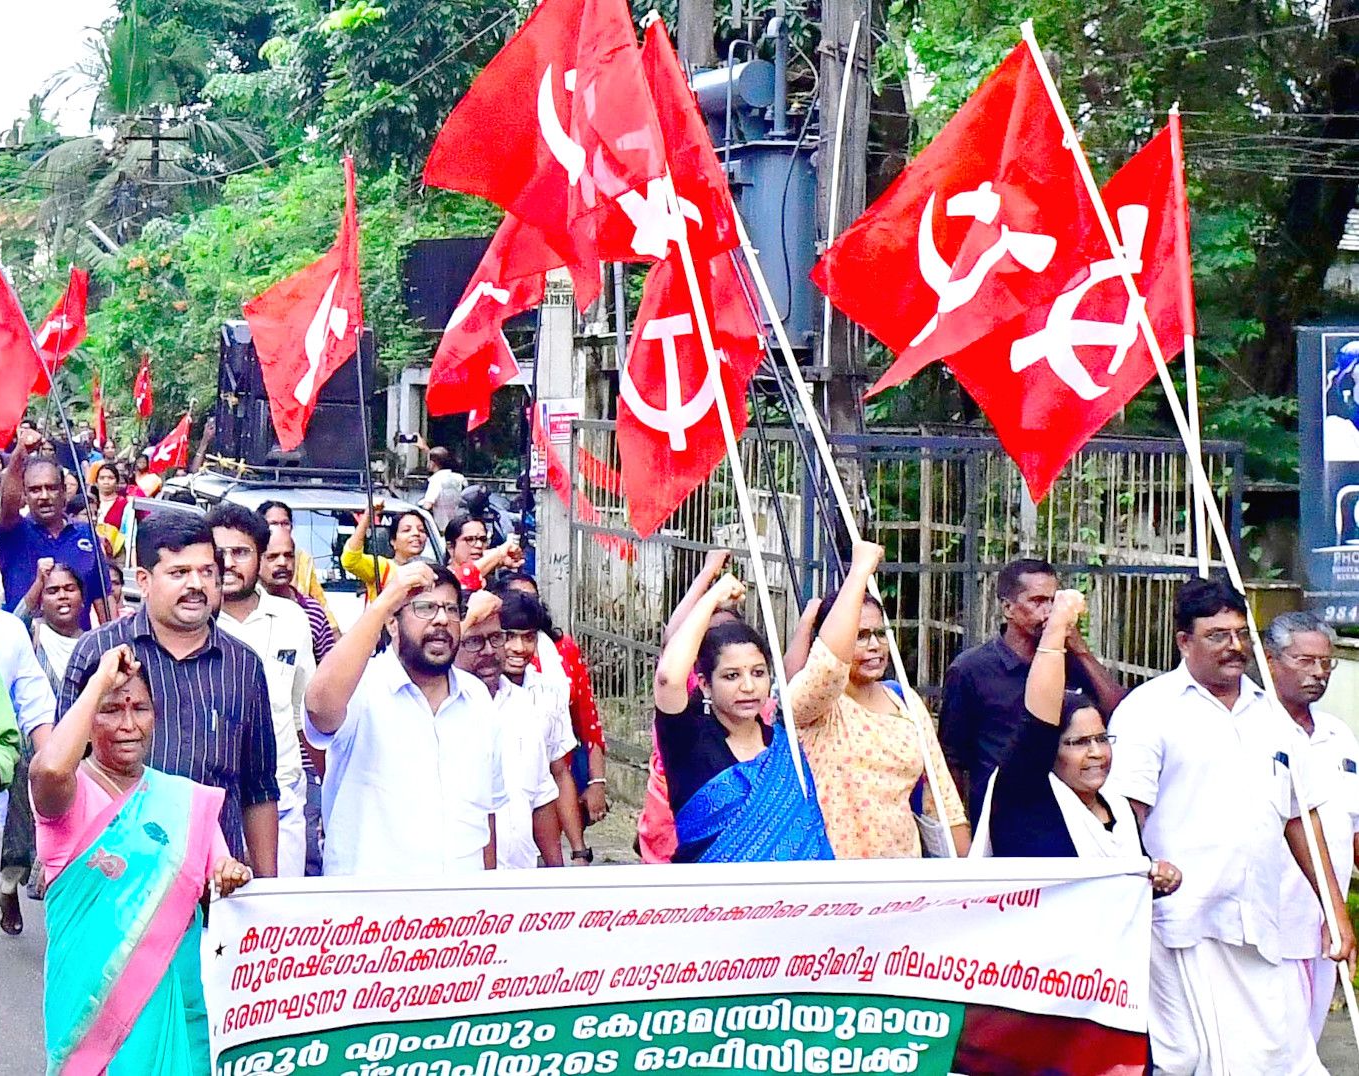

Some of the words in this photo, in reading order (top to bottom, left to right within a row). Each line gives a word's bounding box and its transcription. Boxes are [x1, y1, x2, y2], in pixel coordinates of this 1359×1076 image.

[518, 911, 575, 933] നടന്ന
[223, 988, 347, 1034] ഭരണഘടനാ
[488, 967, 605, 999] ജനാധിപത്യ
